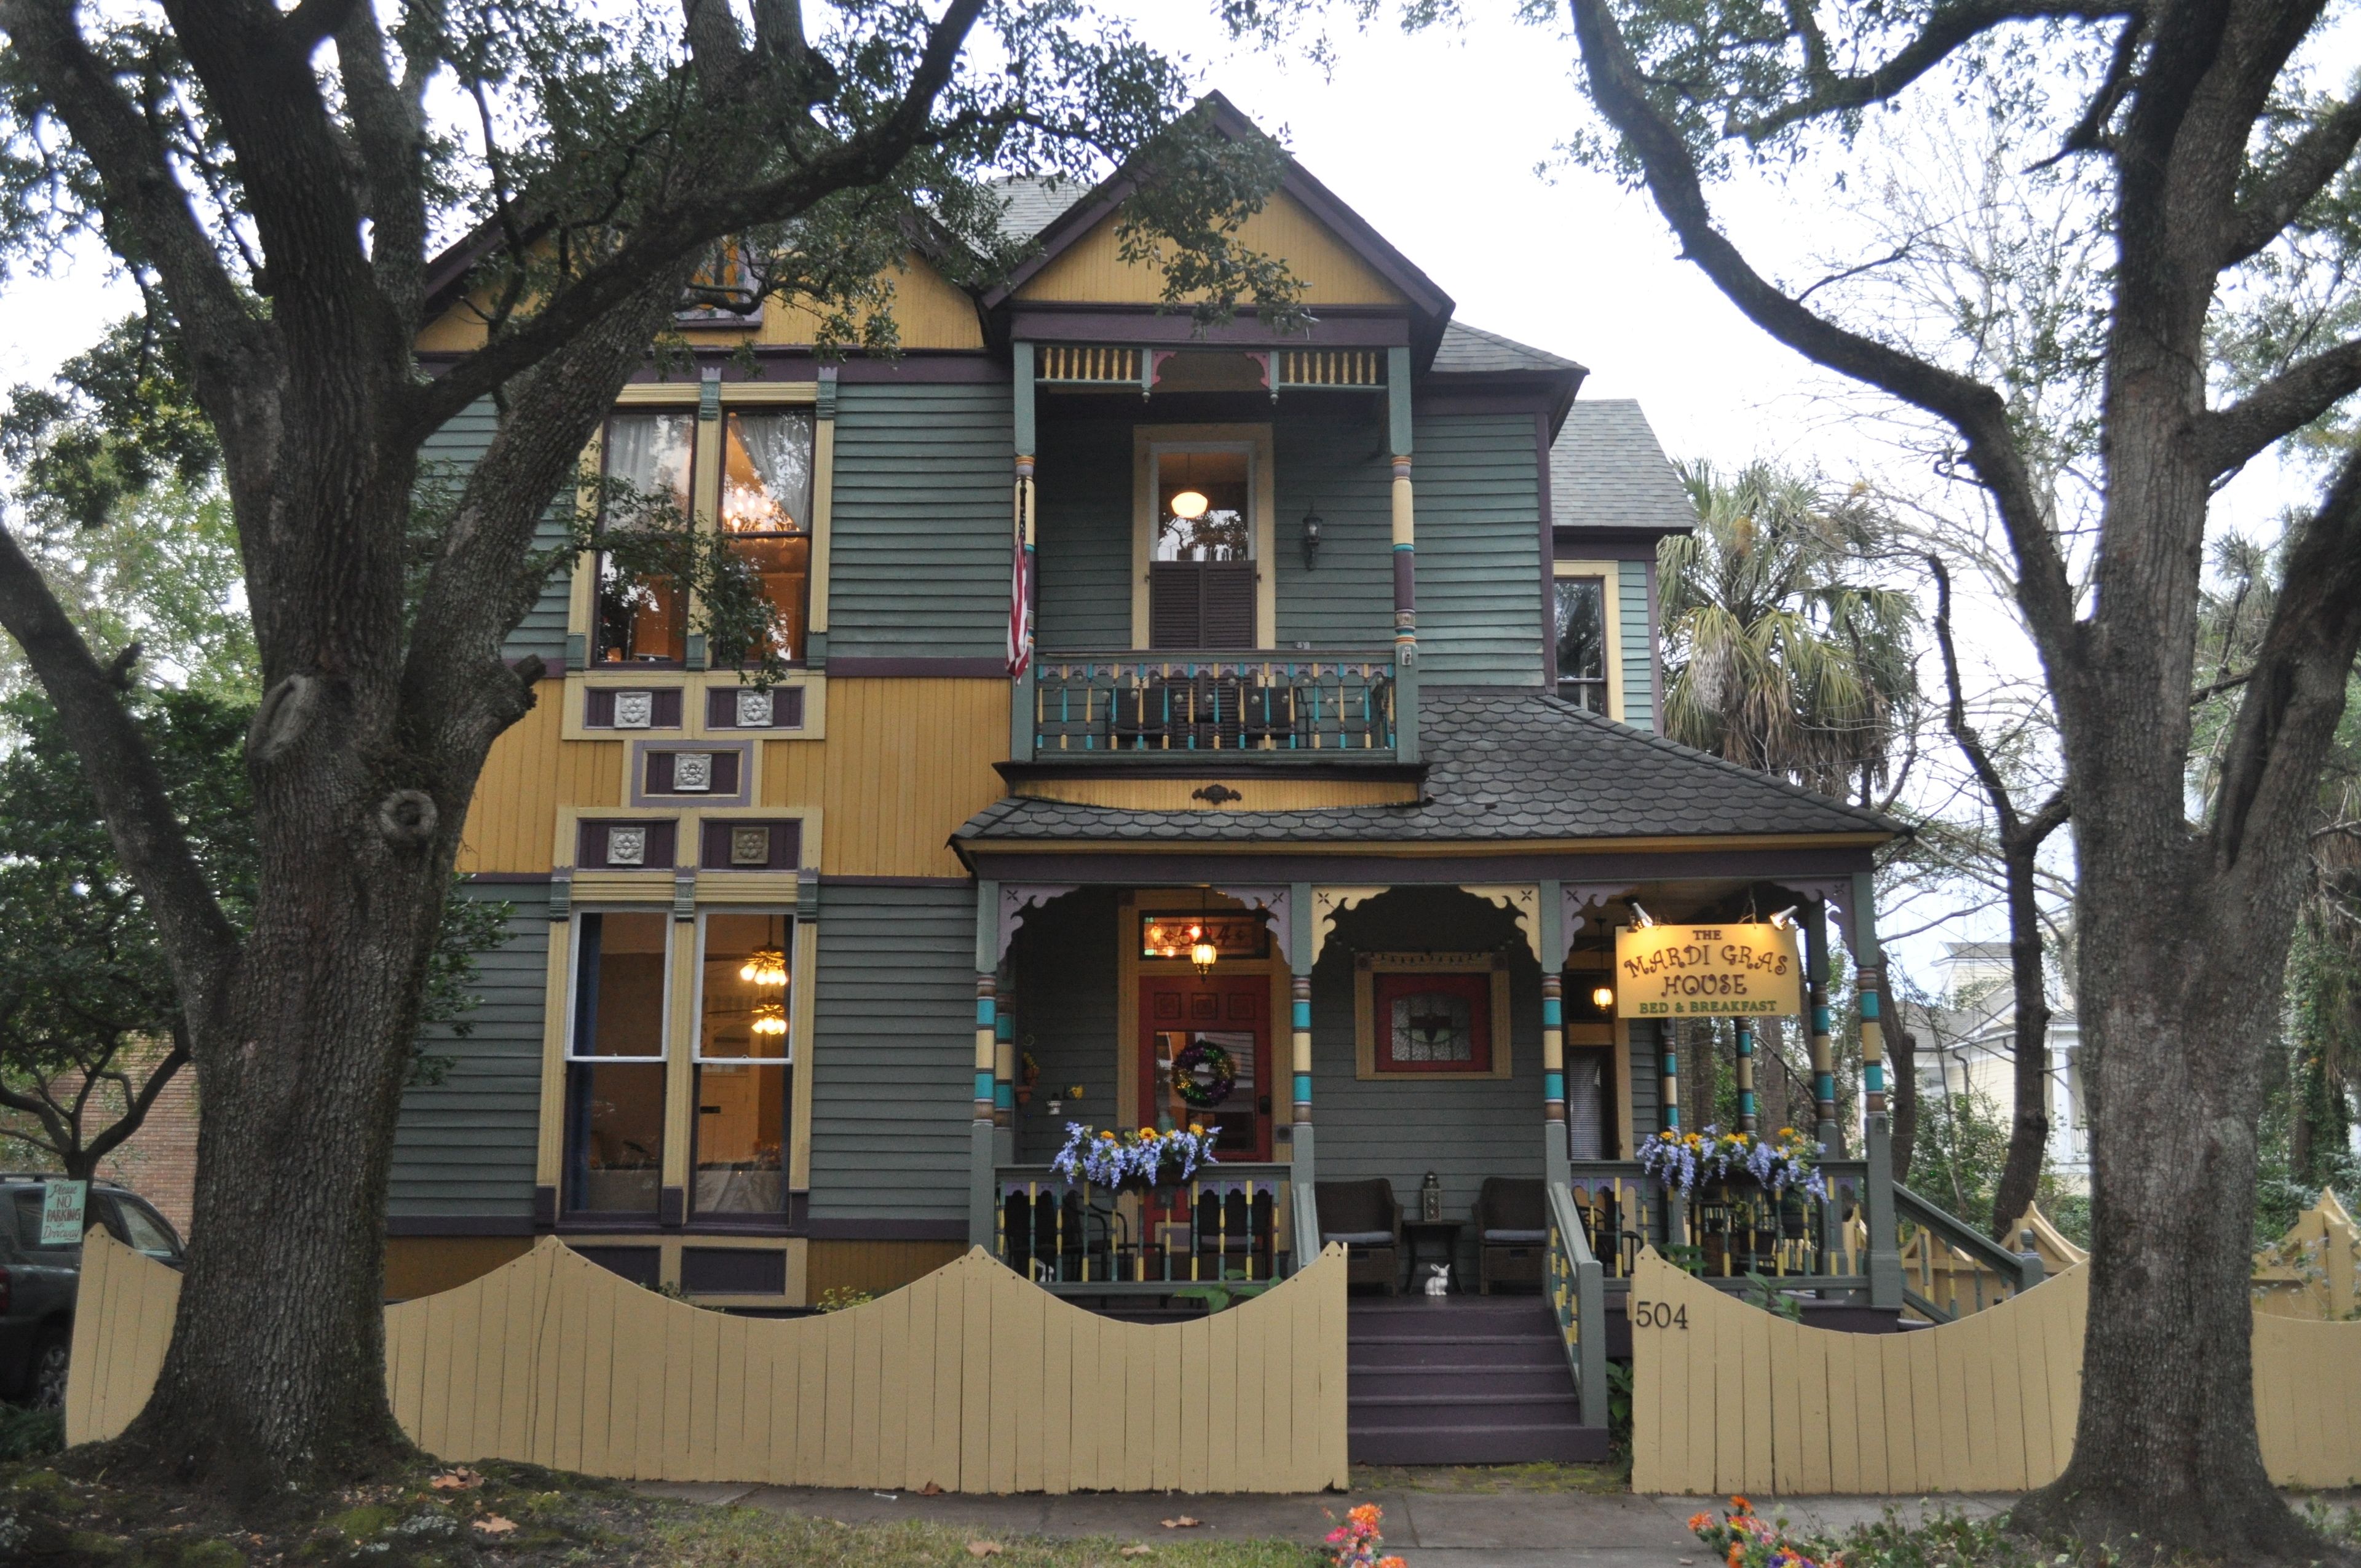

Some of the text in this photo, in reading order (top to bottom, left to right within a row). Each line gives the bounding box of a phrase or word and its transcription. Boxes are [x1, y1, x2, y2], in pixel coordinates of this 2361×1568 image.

[1693, 930, 1722, 940] THE
[1624, 944, 1788, 978] MARDI GRAS
[1661, 974, 1747, 997] HOUSE
[1639, 1000, 1777, 1014] BED & BREAKFAST
[48, 1184, 77, 1198] Please
[57, 1195, 73, 1208] NO
[46, 1208, 81, 1222] PARKING
[1635, 1301, 1688, 1329] 504
